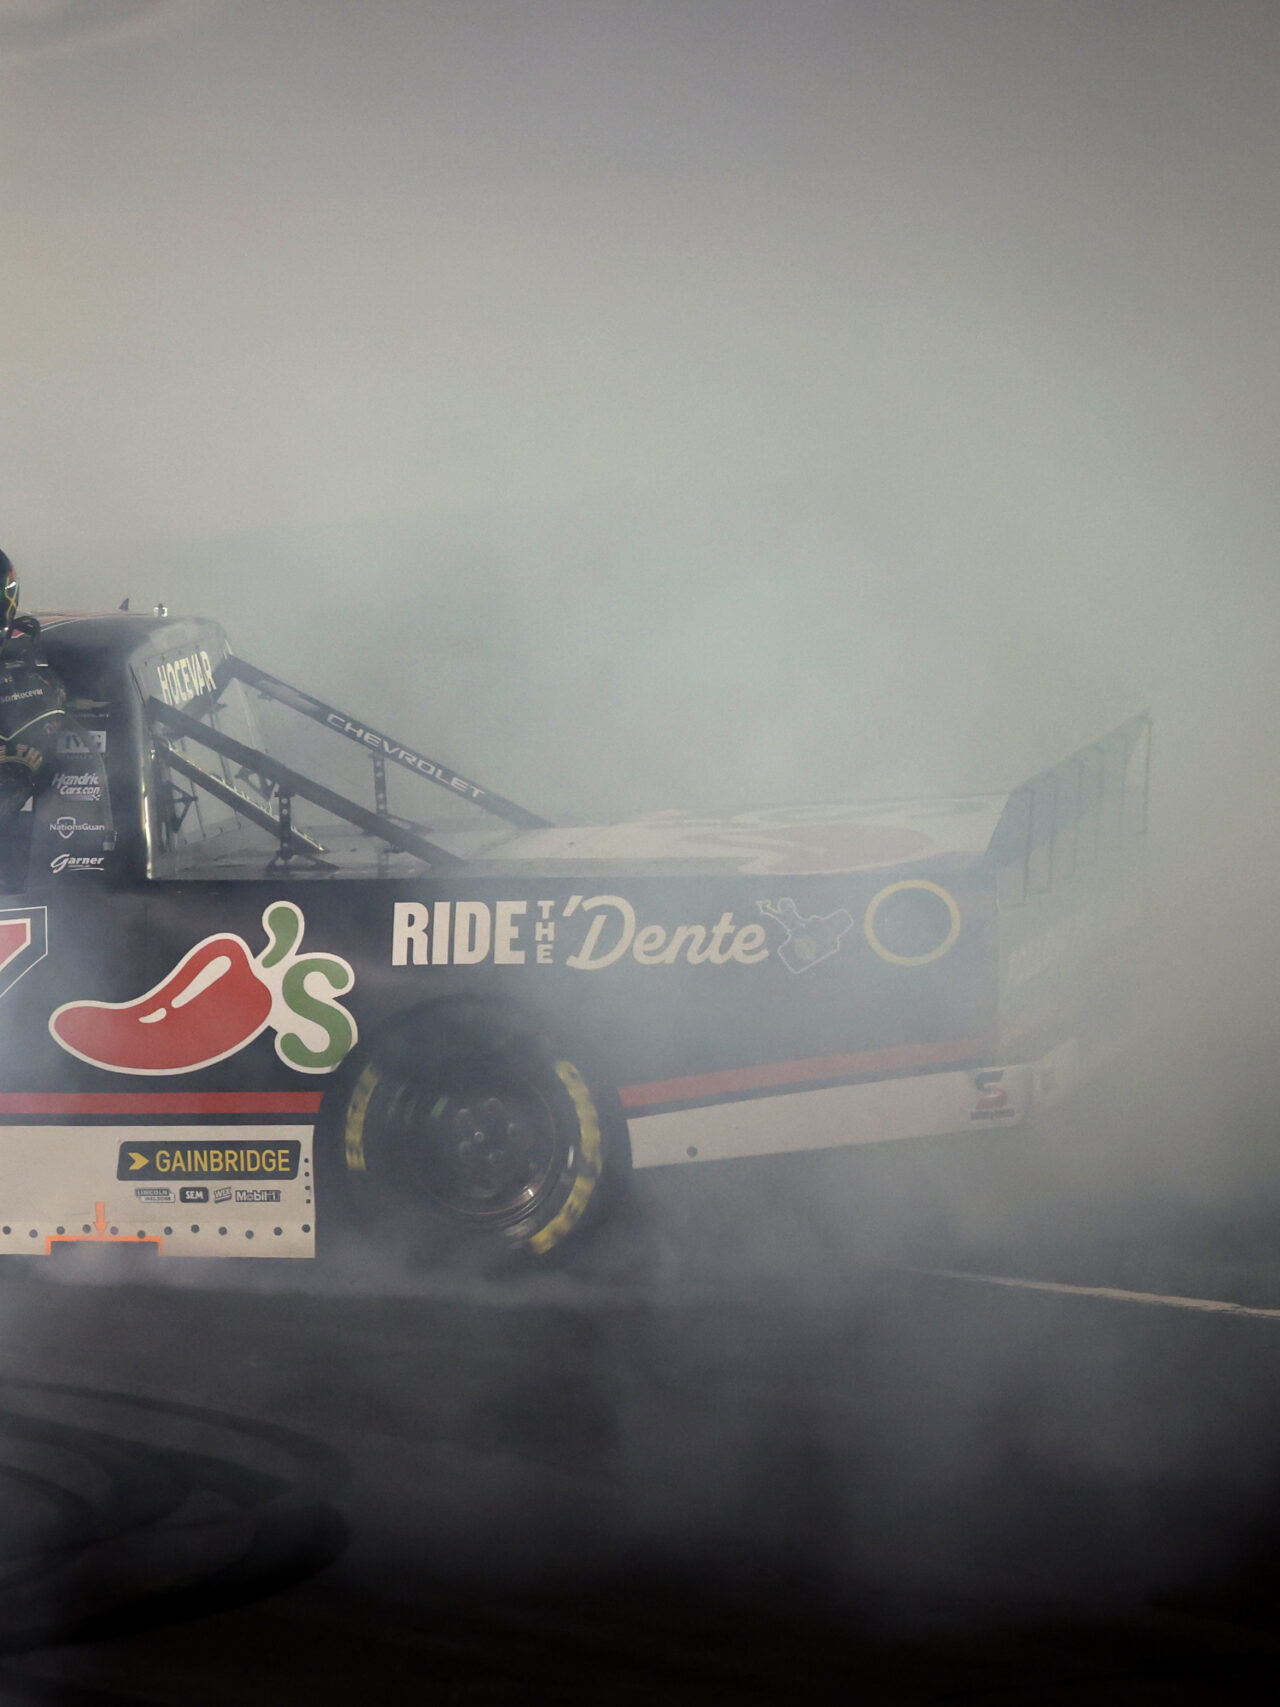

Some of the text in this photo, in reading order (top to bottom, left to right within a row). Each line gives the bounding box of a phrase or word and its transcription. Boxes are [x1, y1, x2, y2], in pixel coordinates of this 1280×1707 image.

[156, 650, 217, 706] HOCEVAR
[326, 713, 489, 799] CHEVROLET
[49, 852, 105, 875] Garner
[391, 900, 527, 967] RIDE
[154, 1148, 291, 1173] GAINBRIDGE
[185, 1190, 204, 1200] SEM
